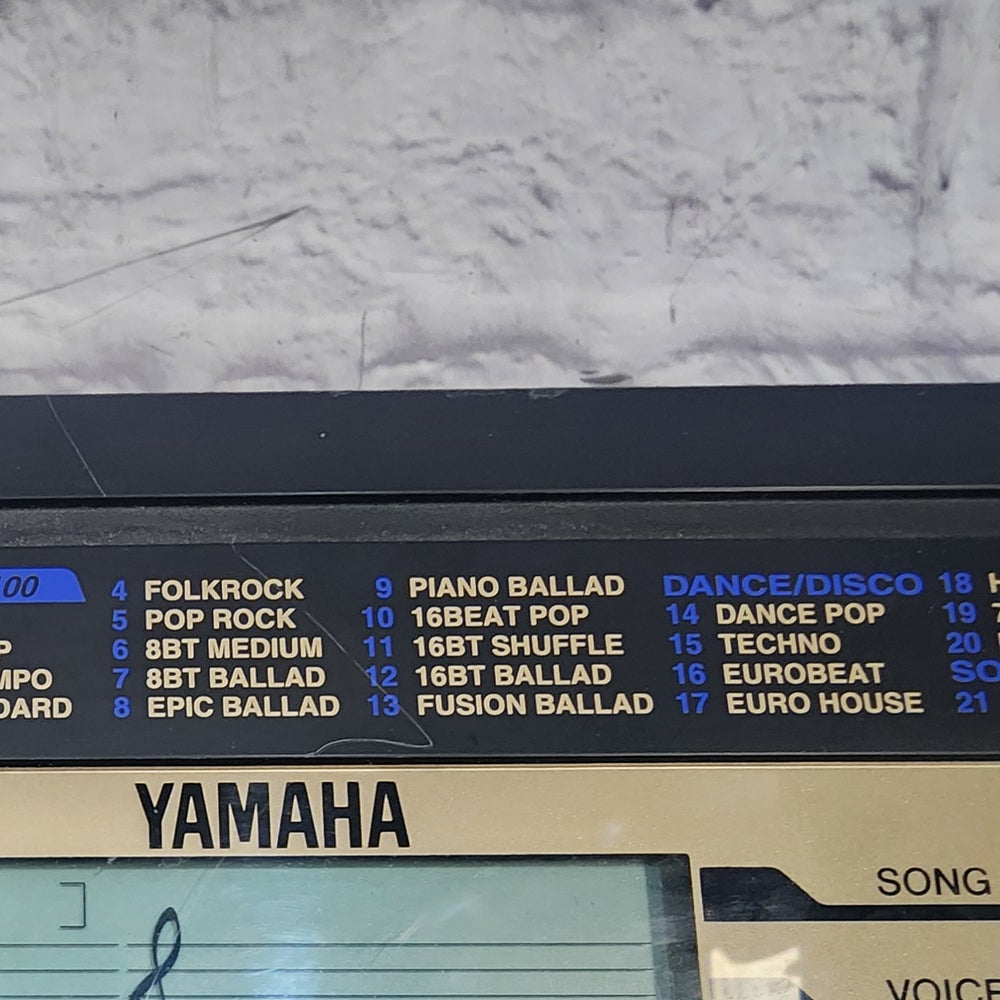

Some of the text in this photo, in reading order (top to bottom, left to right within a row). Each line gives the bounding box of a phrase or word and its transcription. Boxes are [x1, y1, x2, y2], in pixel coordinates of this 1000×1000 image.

[145, 579, 304, 600] FOLKROCK
[410, 575, 624, 597] PIANO BALLAD
[664, 573, 924, 597] DANCE/DISCO
[146, 608, 296, 630] POP ROCK
[411, 605, 588, 627] 16BEAT POP
[716, 603, 885, 624] DANCE POP
[146, 637, 322, 659] 8BT MEDIUM
[413, 634, 624, 656] 16BT SHUFFLE
[718, 633, 841, 654] TECHNO
[146, 667, 325, 689] 8BT BALLAD
[415, 664, 611, 686] 16BT BALLAD
[723, 663, 884, 684] EUROBEAT
[148, 696, 339, 717] EPIC BALLAD
[418, 693, 653, 715] FUSION BALLAD
[727, 692, 924, 714] EURO HOUSE
[135, 781, 410, 849] YAMAHA
[878, 868, 991, 896] SONG
